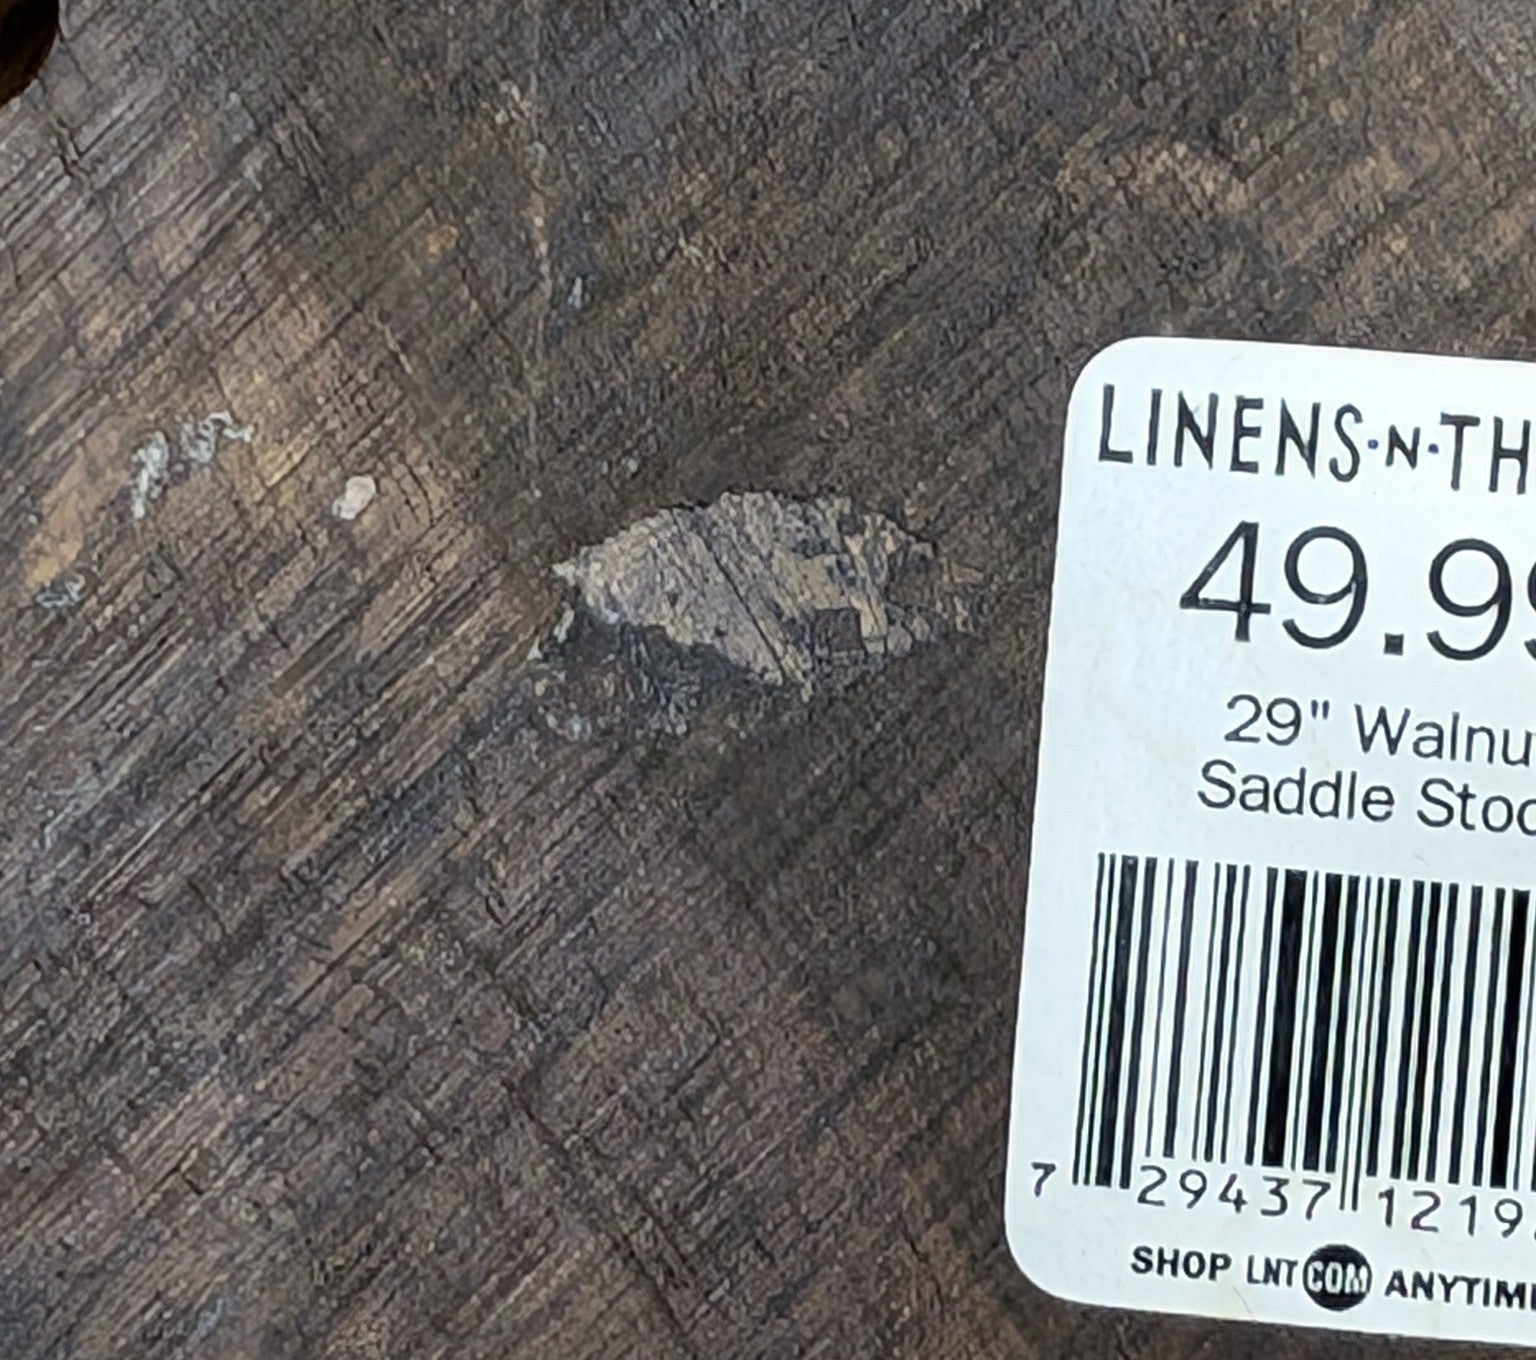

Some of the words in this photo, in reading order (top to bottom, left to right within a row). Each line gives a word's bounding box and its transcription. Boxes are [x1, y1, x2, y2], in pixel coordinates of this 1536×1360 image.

[1224, 694, 1330, 746] 29"
[1197, 759, 1395, 822] Saddle
[1030, 1161, 1057, 1197] 7
[1136, 1164, 1331, 1221] 29437
[1130, 1245, 1232, 1281] SHOP
